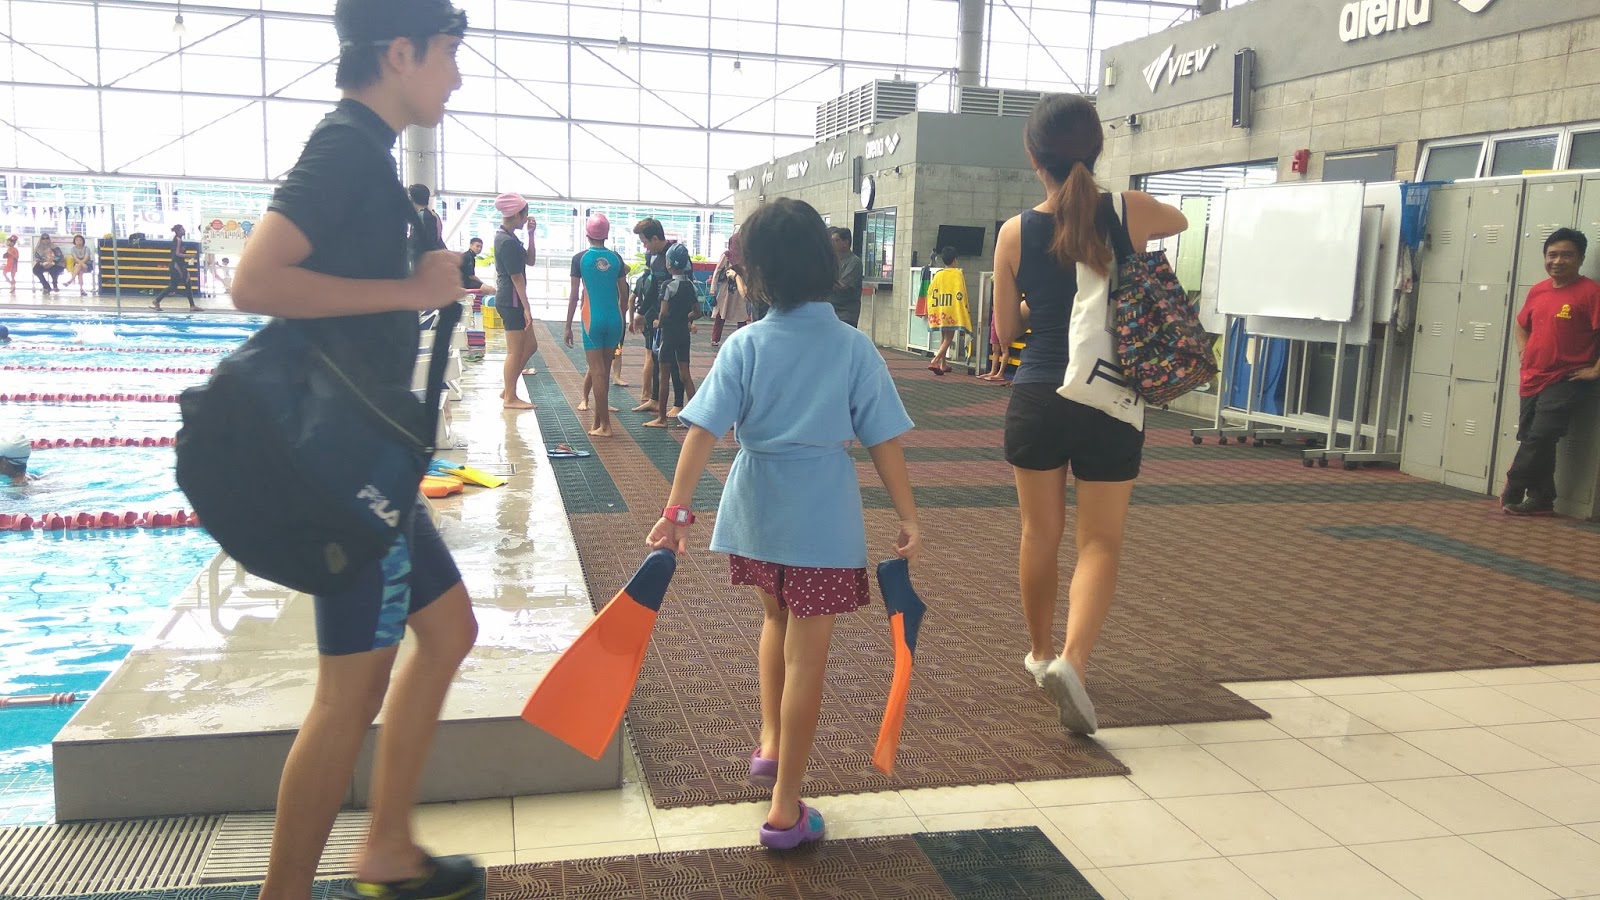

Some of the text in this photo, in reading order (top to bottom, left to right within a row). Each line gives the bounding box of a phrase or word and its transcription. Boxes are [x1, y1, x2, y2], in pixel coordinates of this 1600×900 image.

[1338, 0, 1430, 42] arena
[1168, 45, 1216, 84] VIEW
[931, 288, 952, 307] Sun
